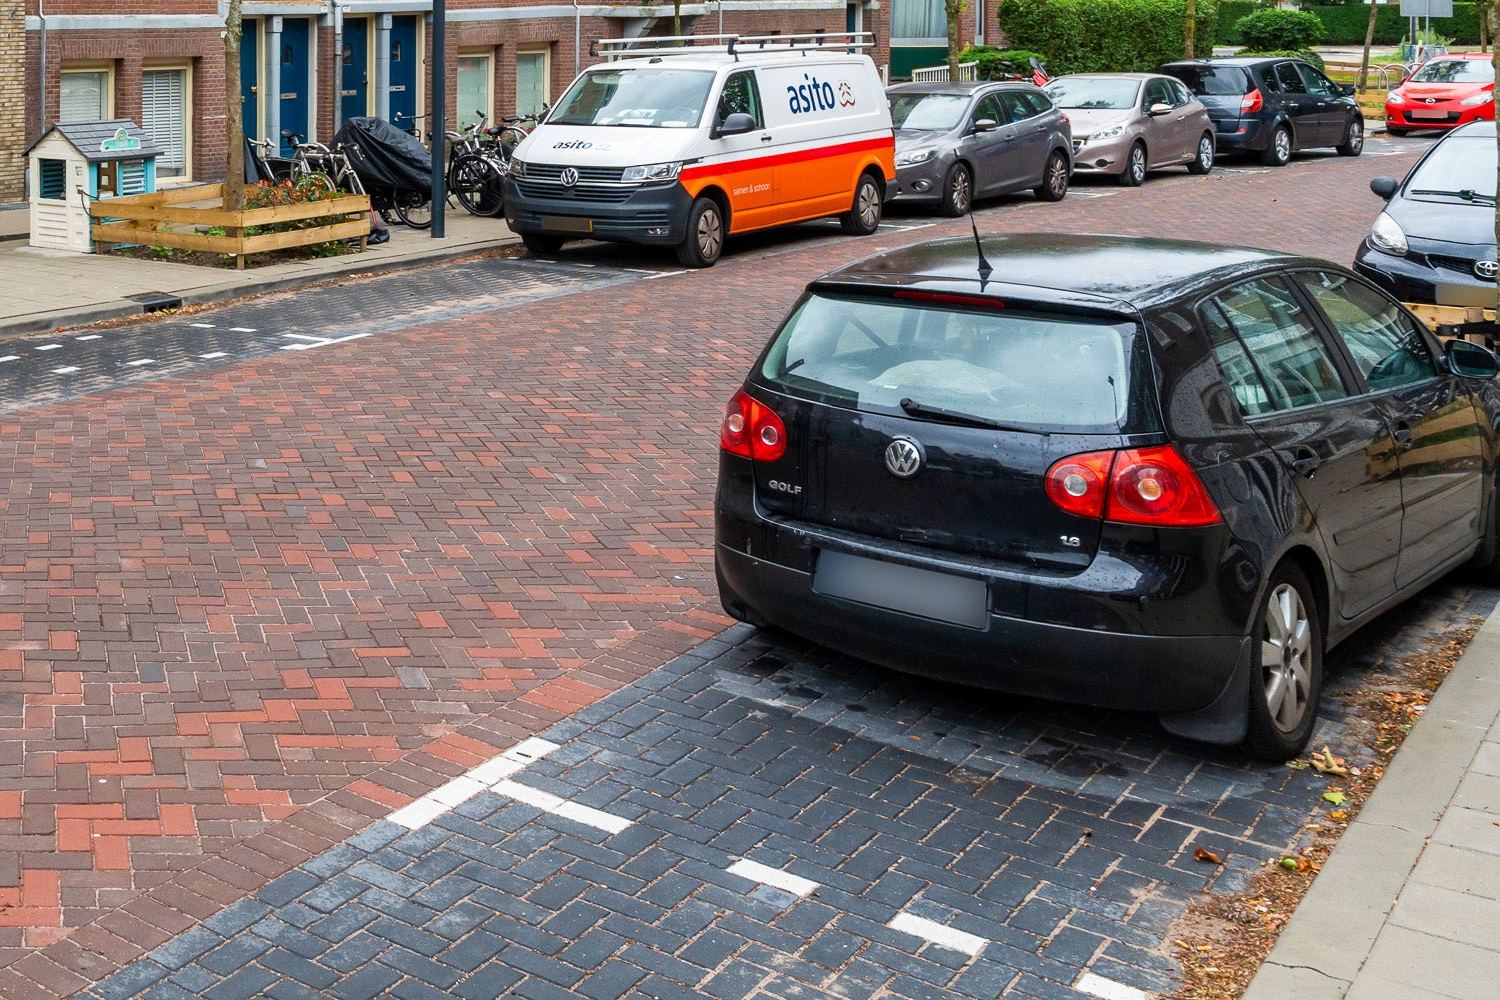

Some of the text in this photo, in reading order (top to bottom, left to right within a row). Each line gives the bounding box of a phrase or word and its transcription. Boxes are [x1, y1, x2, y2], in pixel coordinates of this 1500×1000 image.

[786, 72, 836, 115] asito
[552, 139, 593, 150] asito
[768, 479, 803, 495] GOLF
